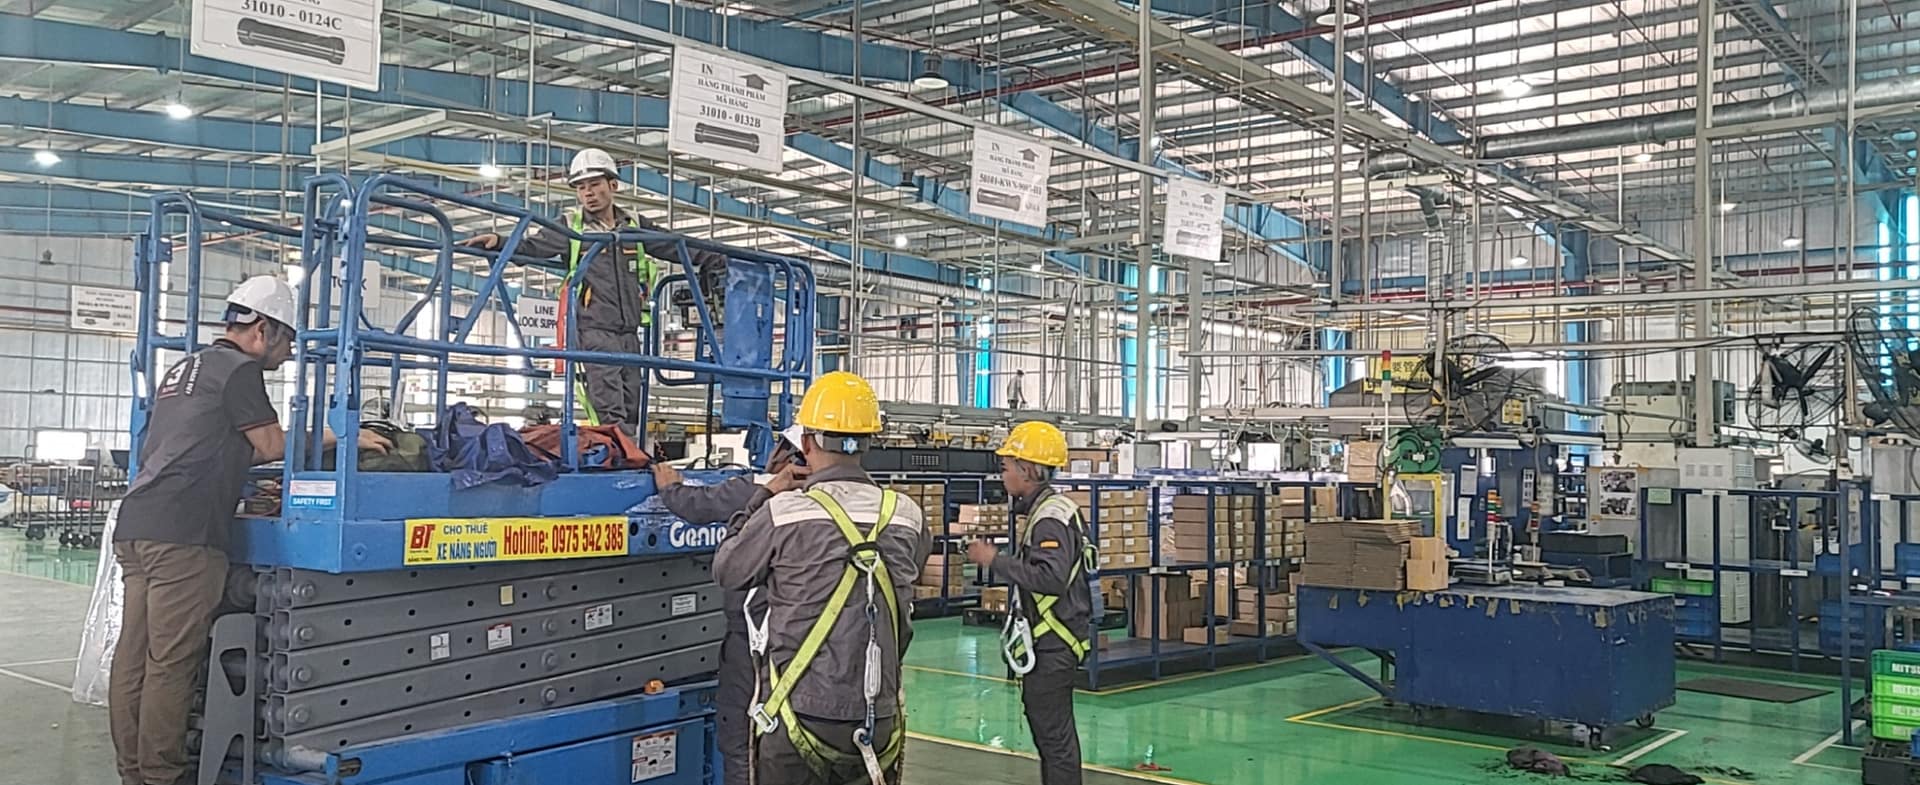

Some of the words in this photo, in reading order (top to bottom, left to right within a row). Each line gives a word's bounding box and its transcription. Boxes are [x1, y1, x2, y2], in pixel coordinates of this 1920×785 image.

[241, 0, 285, 17] 31010
[299, 9, 342, 30] 0124C
[702, 63, 713, 74] IN
[700, 105, 727, 120] 31010
[734, 113, 761, 128] 0132B
[534, 305, 555, 316] LINE
[410, 524, 436, 549] BT
[443, 525, 463, 535] CHO
[503, 525, 549, 555] Hotline:
[552, 524, 579, 553] 0975
[582, 524, 602, 552] 542
[605, 523, 624, 551] 385
[670, 521, 728, 548] Genie
[437, 542, 447, 560] XE
